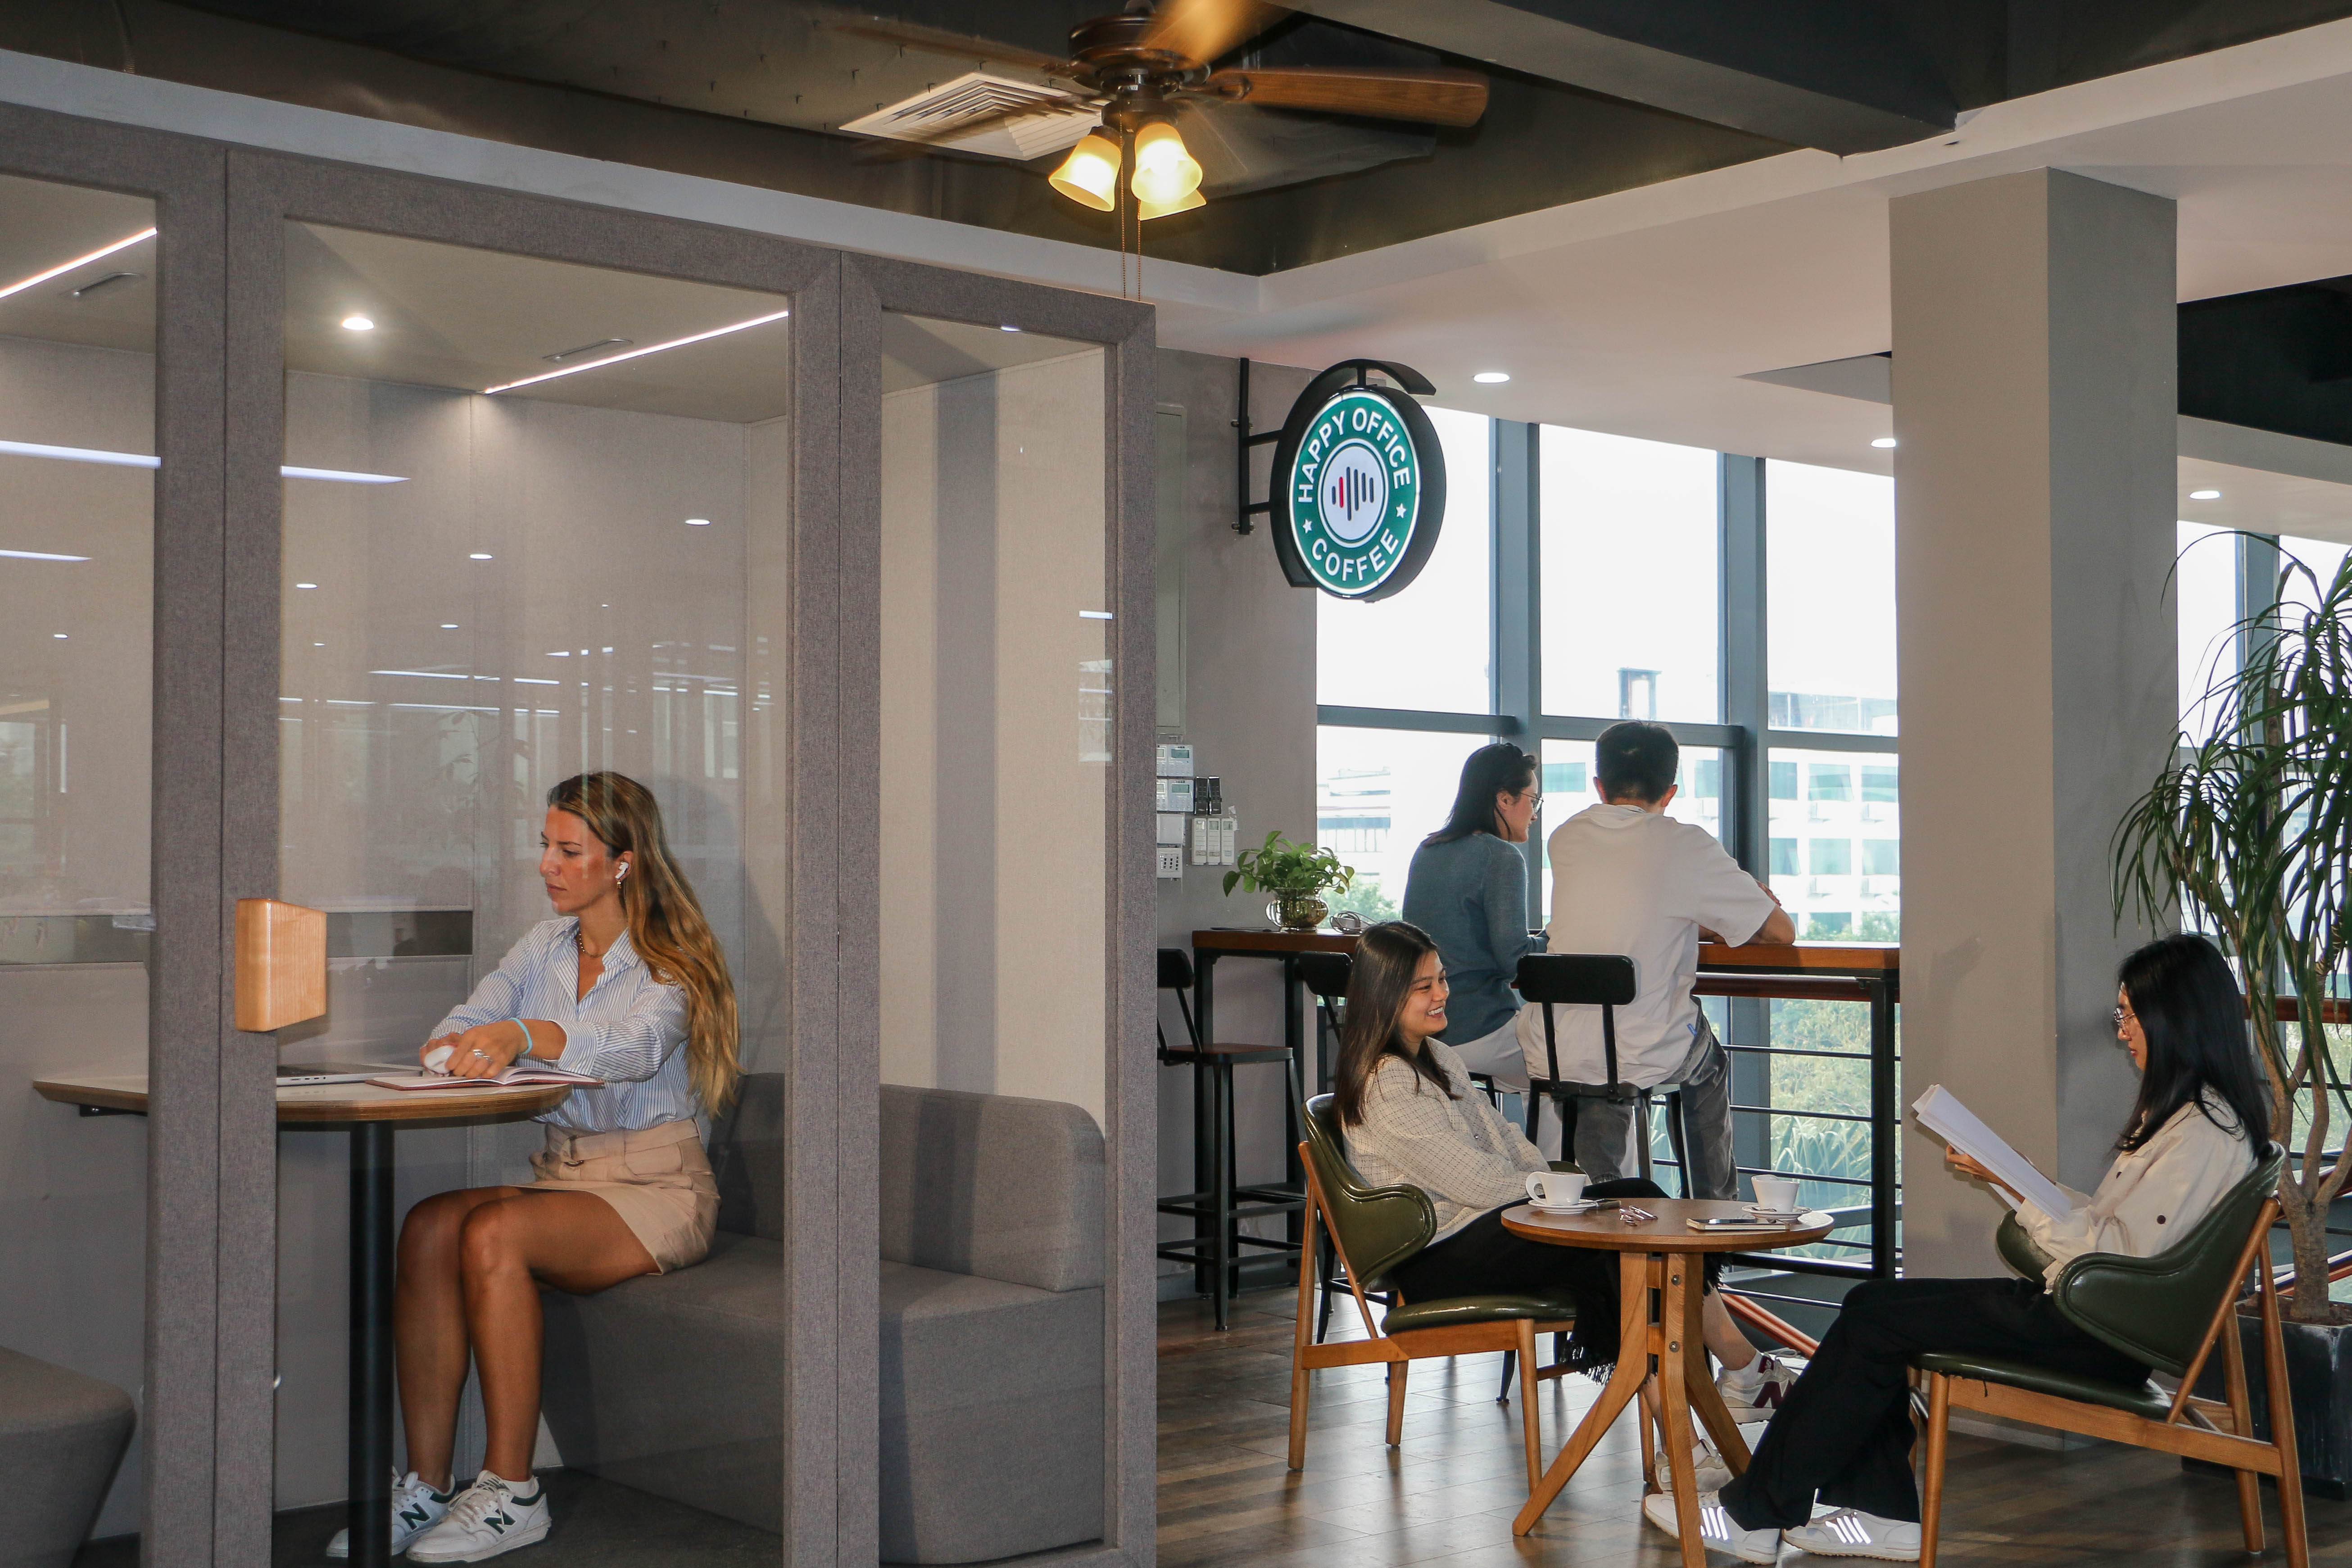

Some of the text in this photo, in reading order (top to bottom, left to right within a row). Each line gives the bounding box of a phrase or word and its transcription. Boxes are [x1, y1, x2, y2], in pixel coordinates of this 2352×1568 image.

[1298, 408, 1410, 503] HAPPY OFFICE
[1312, 529, 1398, 581] COFFEE
[399, 1502, 431, 1532] N
[483, 1508, 517, 1536] N
